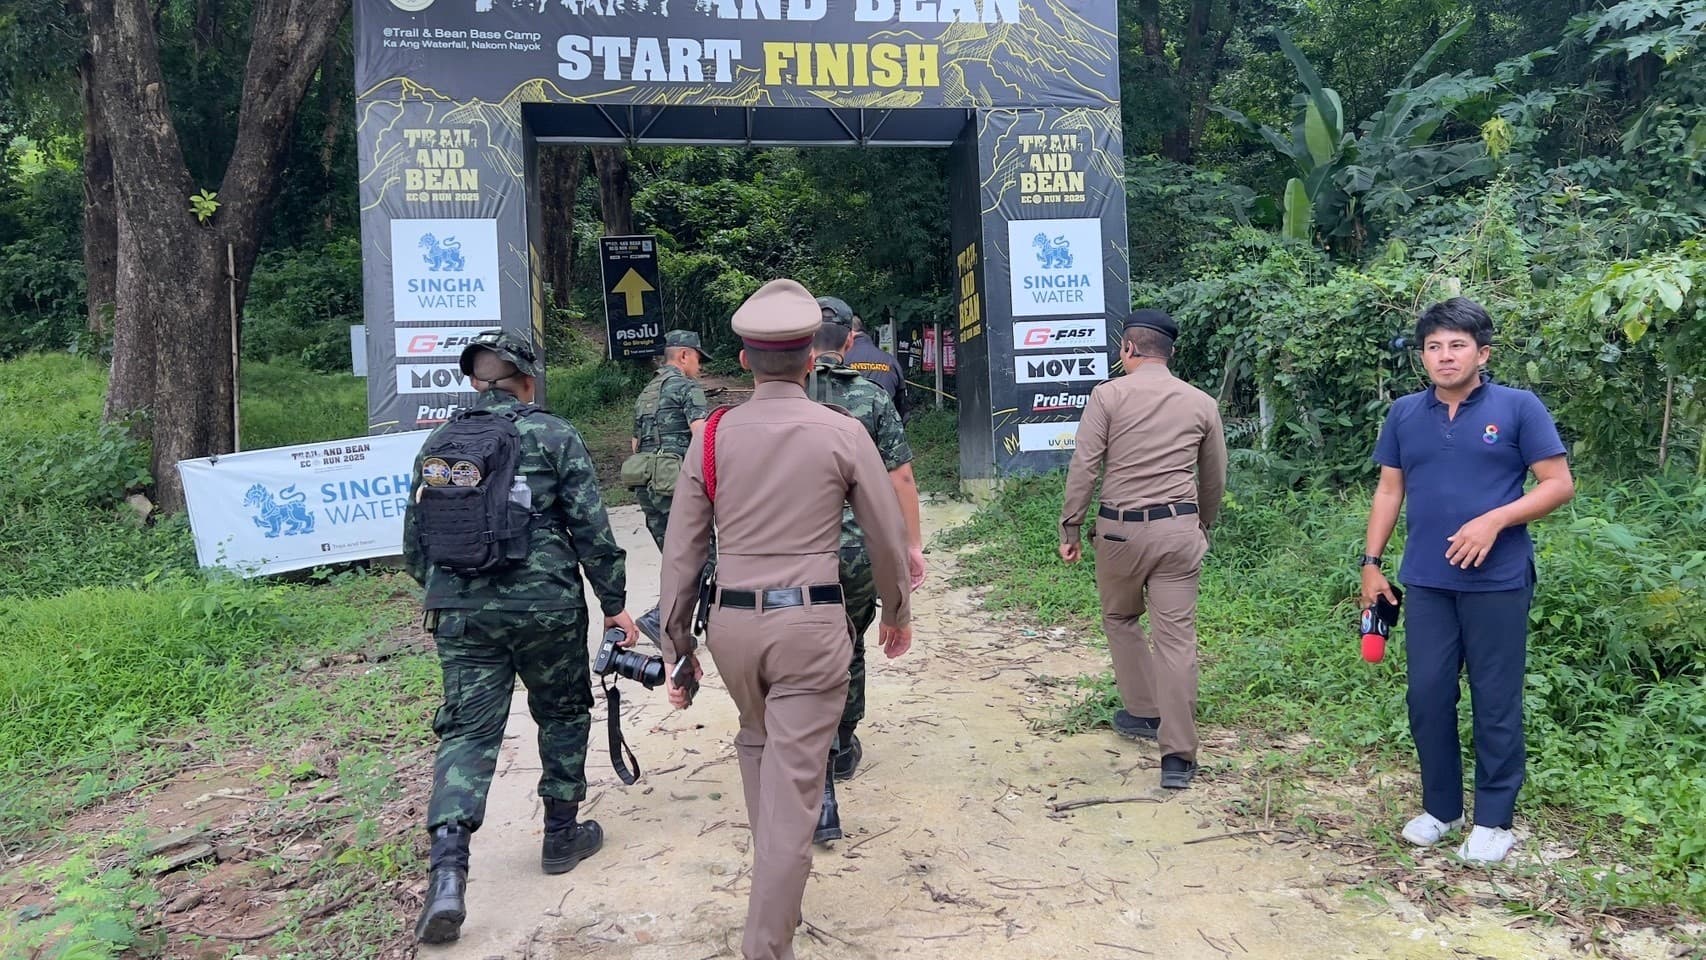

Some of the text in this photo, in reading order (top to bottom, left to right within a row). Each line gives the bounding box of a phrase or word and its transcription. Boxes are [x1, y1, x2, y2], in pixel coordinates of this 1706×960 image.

[422, 28, 432, 38] &
[435, 28, 467, 39] Bean
[470, 29, 501, 39] Base
[504, 30, 542, 41] Camp
[383, 40, 397, 48] Ka
[399, 39, 420, 50] Ang
[421, 40, 469, 50] Waterfall,
[509, 42, 542, 51] Nayok
[556, 34, 940, 86] START FINISH
[404, 128, 478, 148] TRAIL
[1018, 134, 1083, 153] TRAIL
[415, 148, 465, 168] AND
[1029, 153, 1073, 172] AND
[405, 168, 479, 191] BEAN
[1020, 172, 1085, 193] BEAN
[432, 192, 451, 201] RUN
[455, 192, 479, 201] 2025
[1043, 194, 1061, 203] RUN
[1063, 194, 1085, 203] 2025
[408, 278, 485, 293] SINGHA
[1023, 274, 1091, 290] SINGHA
[418, 294, 478, 309] WATER
[1032, 289, 1084, 304] WATER
[616, 323, 659, 340] ตรงไป
[1024, 328, 1096, 346] G-FAST
[1027, 357, 1096, 378] MOVE
[1482, 424, 1499, 444] 8
[323, 447, 342, 457] AND
[345, 444, 371, 454] BEAN
[1048, 439, 1062, 447] UV
[323, 456, 341, 465] RUN
[343, 453, 365, 462] 2025
